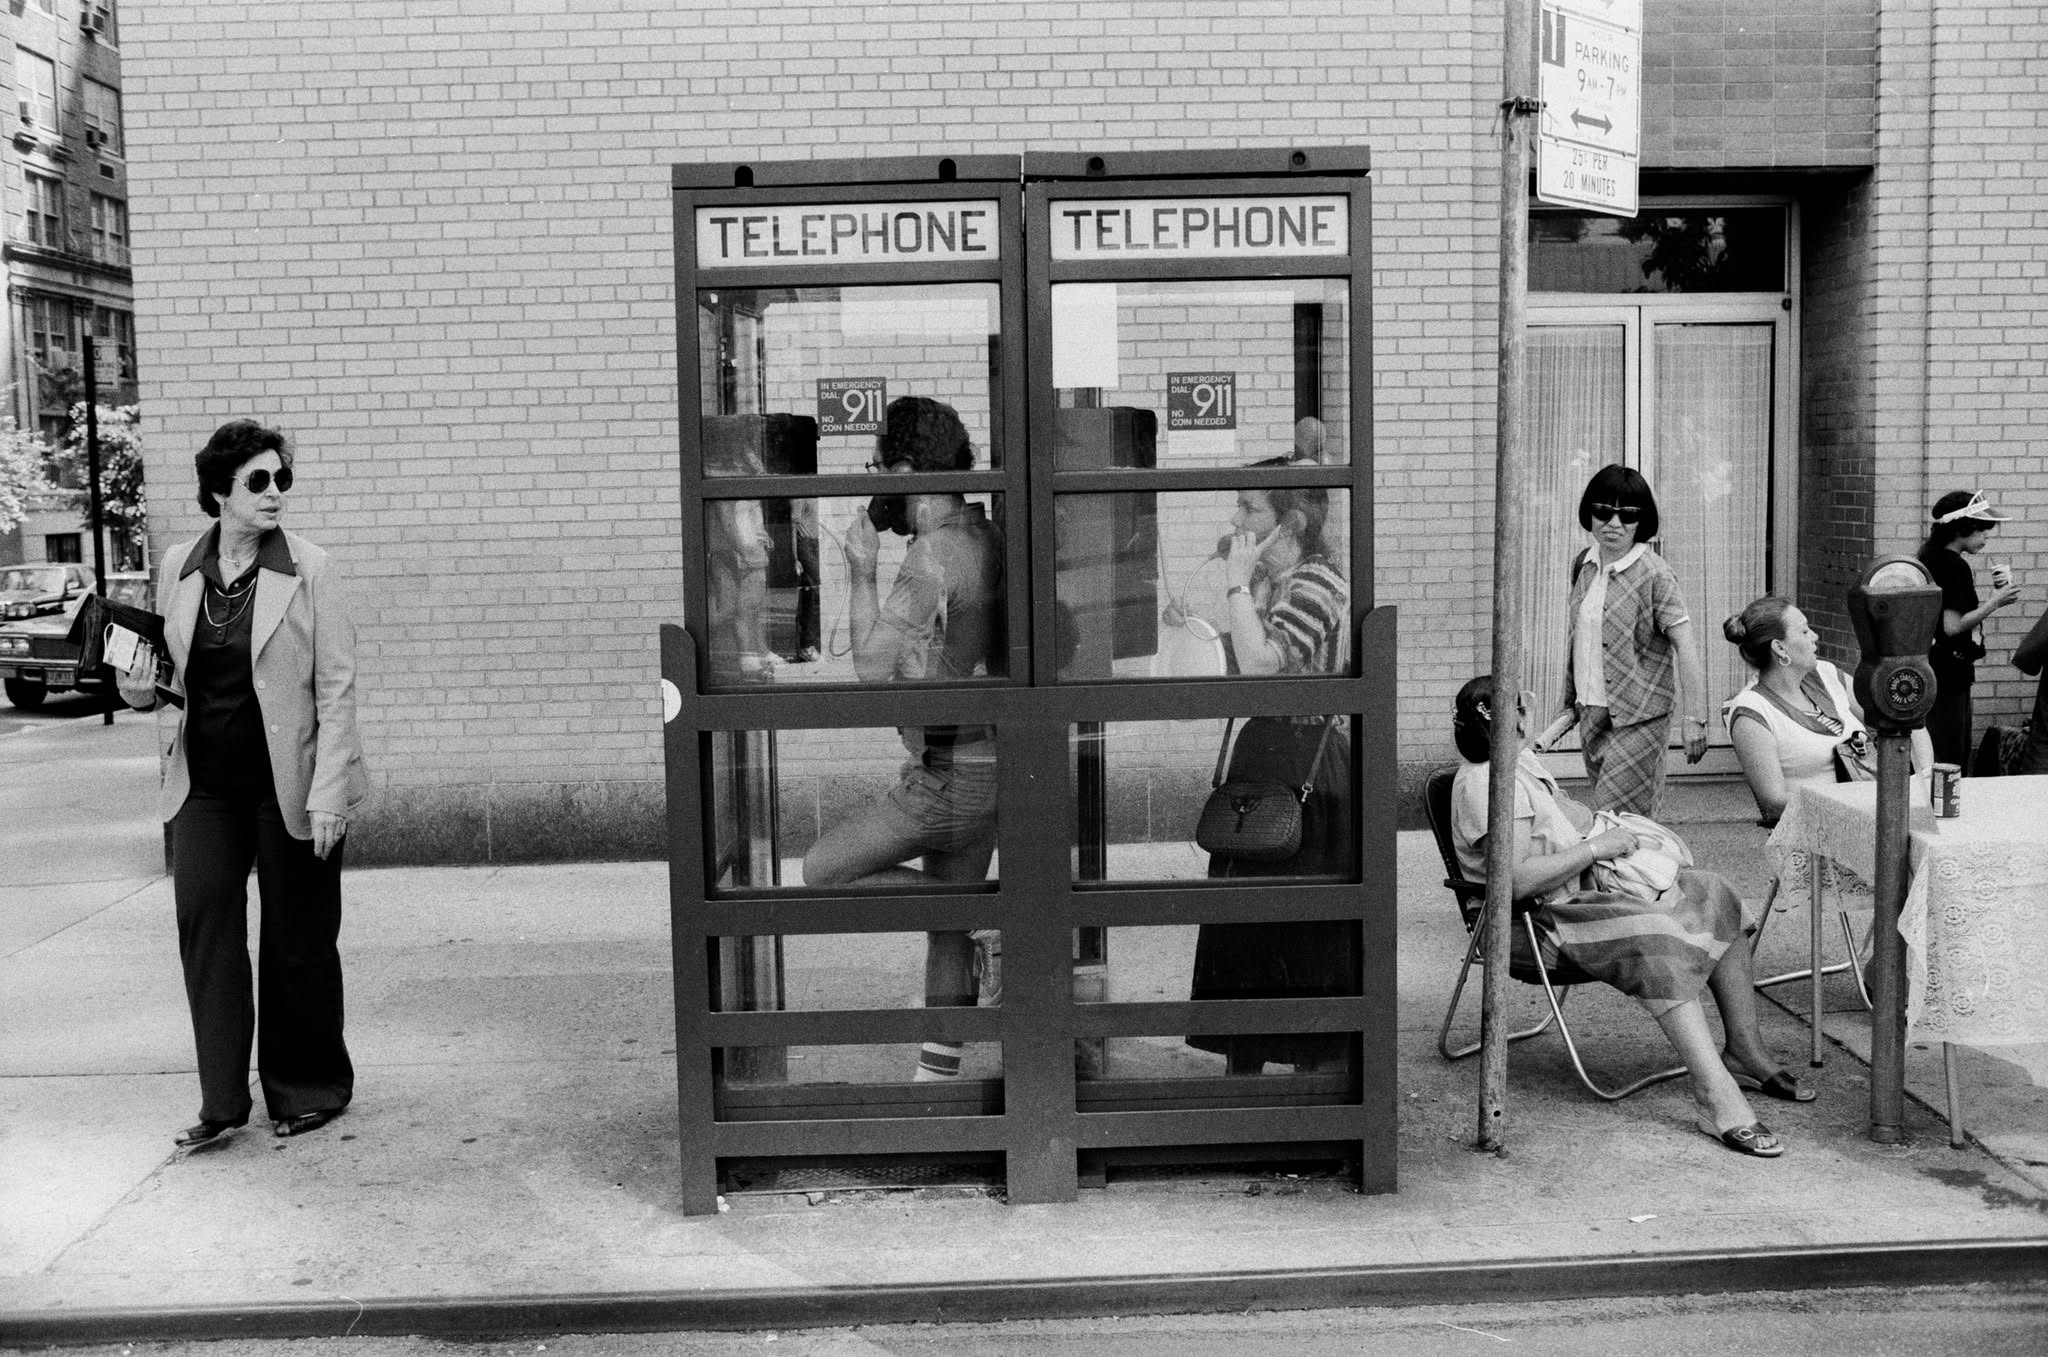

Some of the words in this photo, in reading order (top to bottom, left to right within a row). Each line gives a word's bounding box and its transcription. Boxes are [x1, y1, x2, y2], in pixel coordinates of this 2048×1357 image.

[1575, 41, 1629, 73] PARKING
[1593, 152, 1608, 171] PER
[1563, 169, 1575, 190] 20
[1581, 173, 1617, 197] MINUTES
[709, 210, 987, 258] TELEPHONE
[1062, 205, 1336, 251] TELEPHONE
[821, 381, 829, 390] IN
[832, 381, 882, 390] EMERGENCY
[1171, 376, 1180, 384] IN
[1182, 375, 1232, 384] EMERGENCY
[842, 389, 882, 422] 911
[1192, 383, 1232, 417] 911
[822, 415, 834, 423] NO
[1171, 409, 1184, 418] NO
[1171, 418, 1192, 427] COIN
[1194, 417, 1227, 426] NEEDED
[822, 424, 842, 432] COIN
[844, 423, 878, 432] NEEDED
